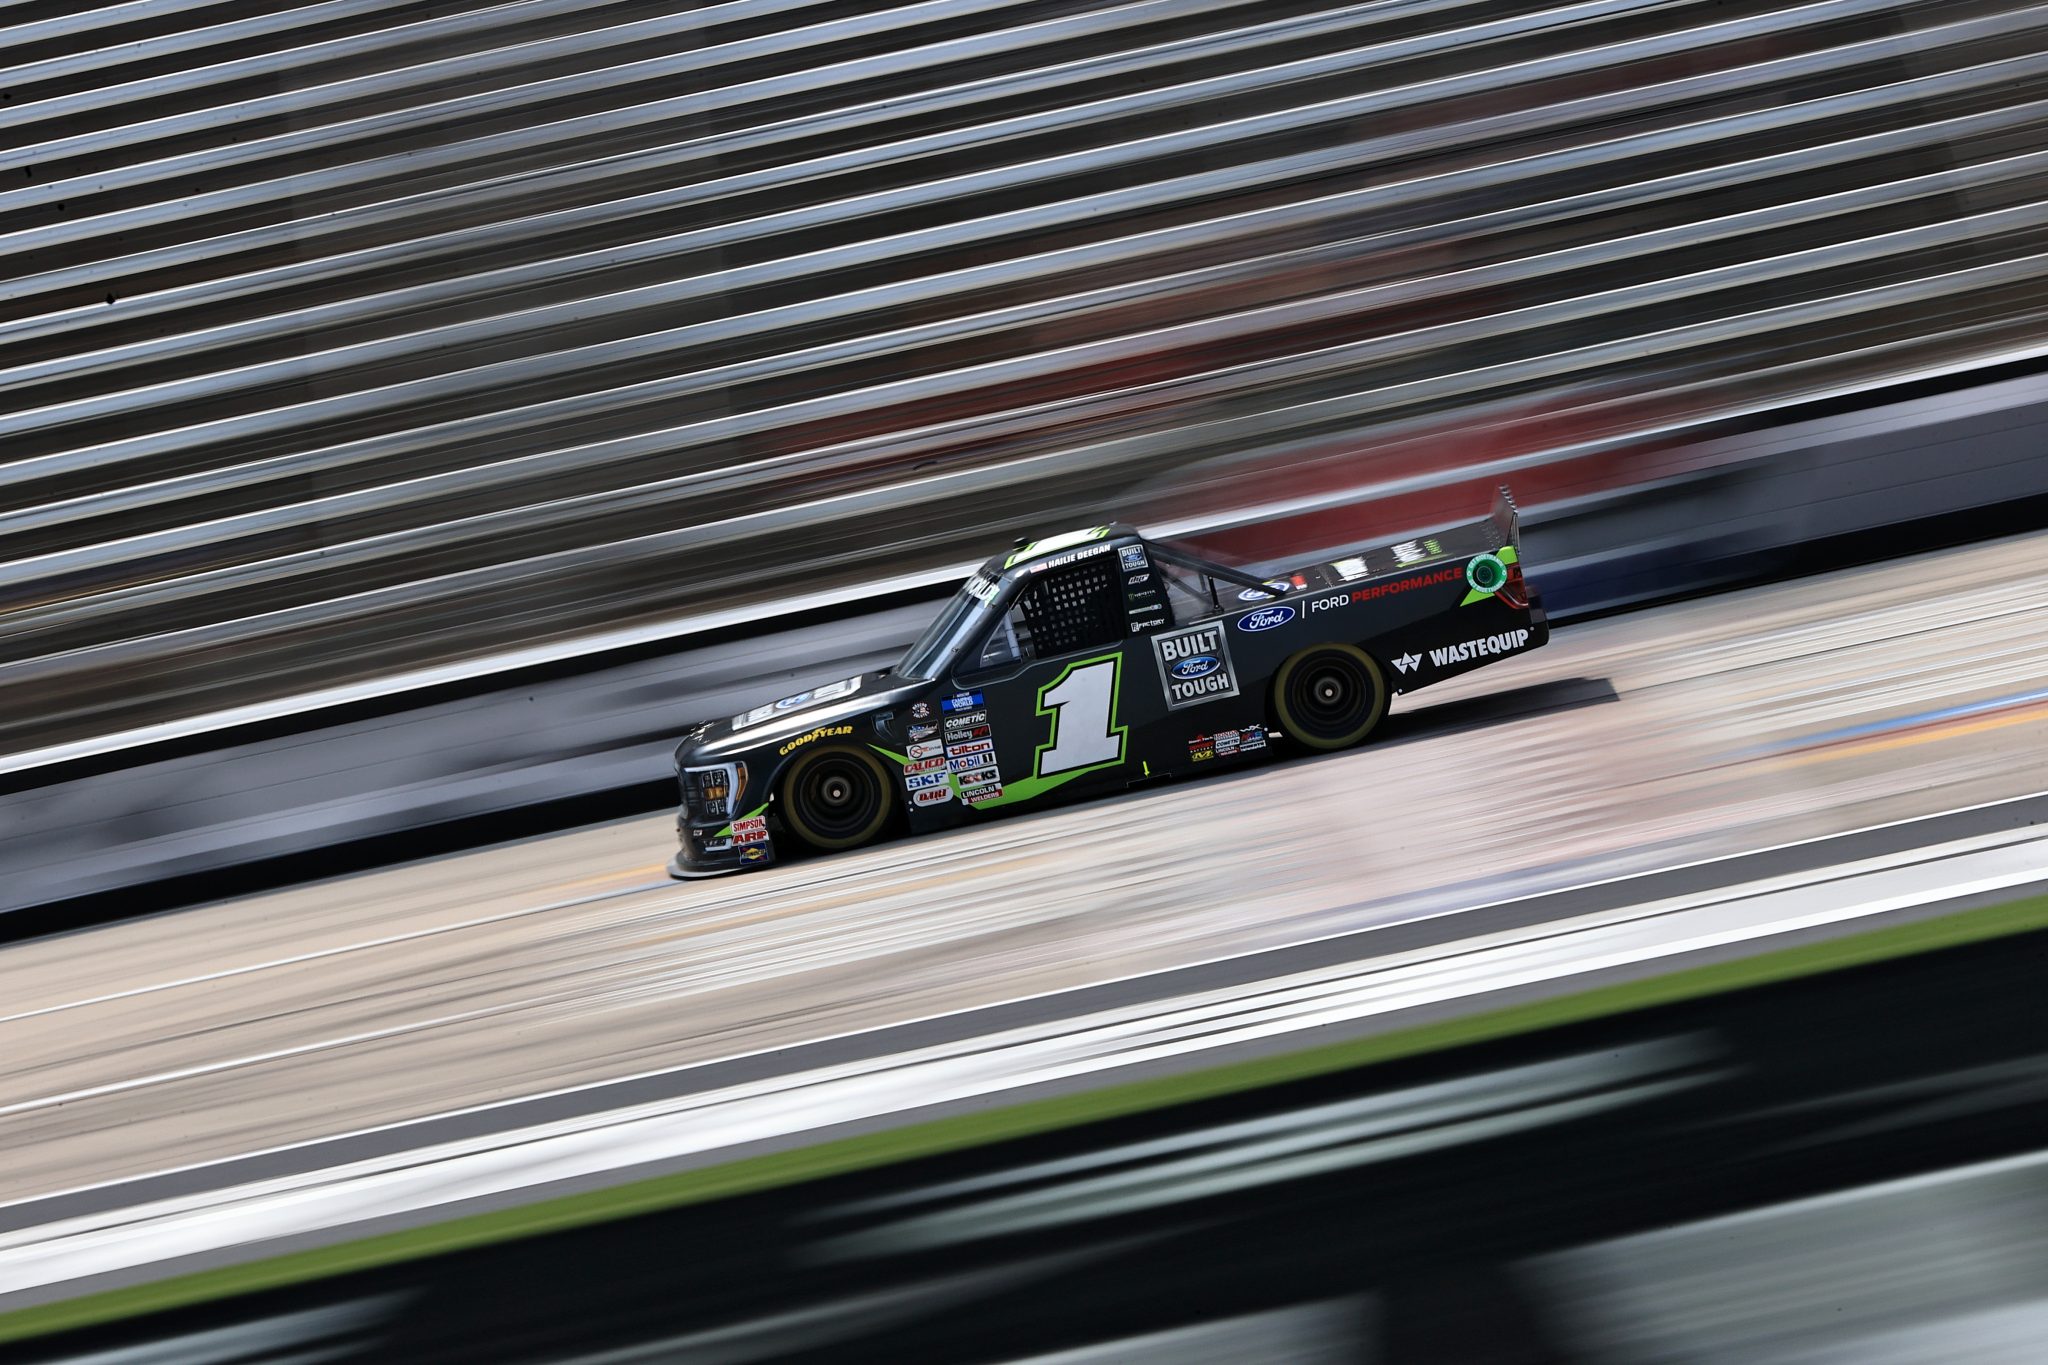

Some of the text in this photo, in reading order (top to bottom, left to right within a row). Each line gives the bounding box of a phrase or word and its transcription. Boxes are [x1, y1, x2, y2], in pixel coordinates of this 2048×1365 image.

[1048, 544, 1111, 568] HAILIE DEEGAN
[1121, 546, 1141, 557] BUILT
[1124, 560, 1145, 569] TOUGH
[1311, 594, 1349, 613] FORD
[1352, 567, 1463, 602] PERFORMANCE
[1249, 609, 1285, 629] Ford
[1161, 630, 1218, 662] BUILT
[1429, 629, 1529, 667] WASTEQUIP
[1181, 660, 1209, 675] Ford
[1171, 673, 1230, 699] TOUGH
[946, 713, 985, 728] COMETIC
[1037, 656, 1124, 777] 1
[779, 725, 853, 756] GOODYEAR
[946, 730, 973, 742] Holley
[949, 742, 990, 756] tilton
[949, 756, 980, 771] Mobil
[909, 772, 946, 788] SKF
[962, 785, 995, 798] LINCOLN
[970, 792, 1000, 803] WELDERS
[733, 818, 764, 832] SIMPSON
[732, 830, 767, 844] ARP
